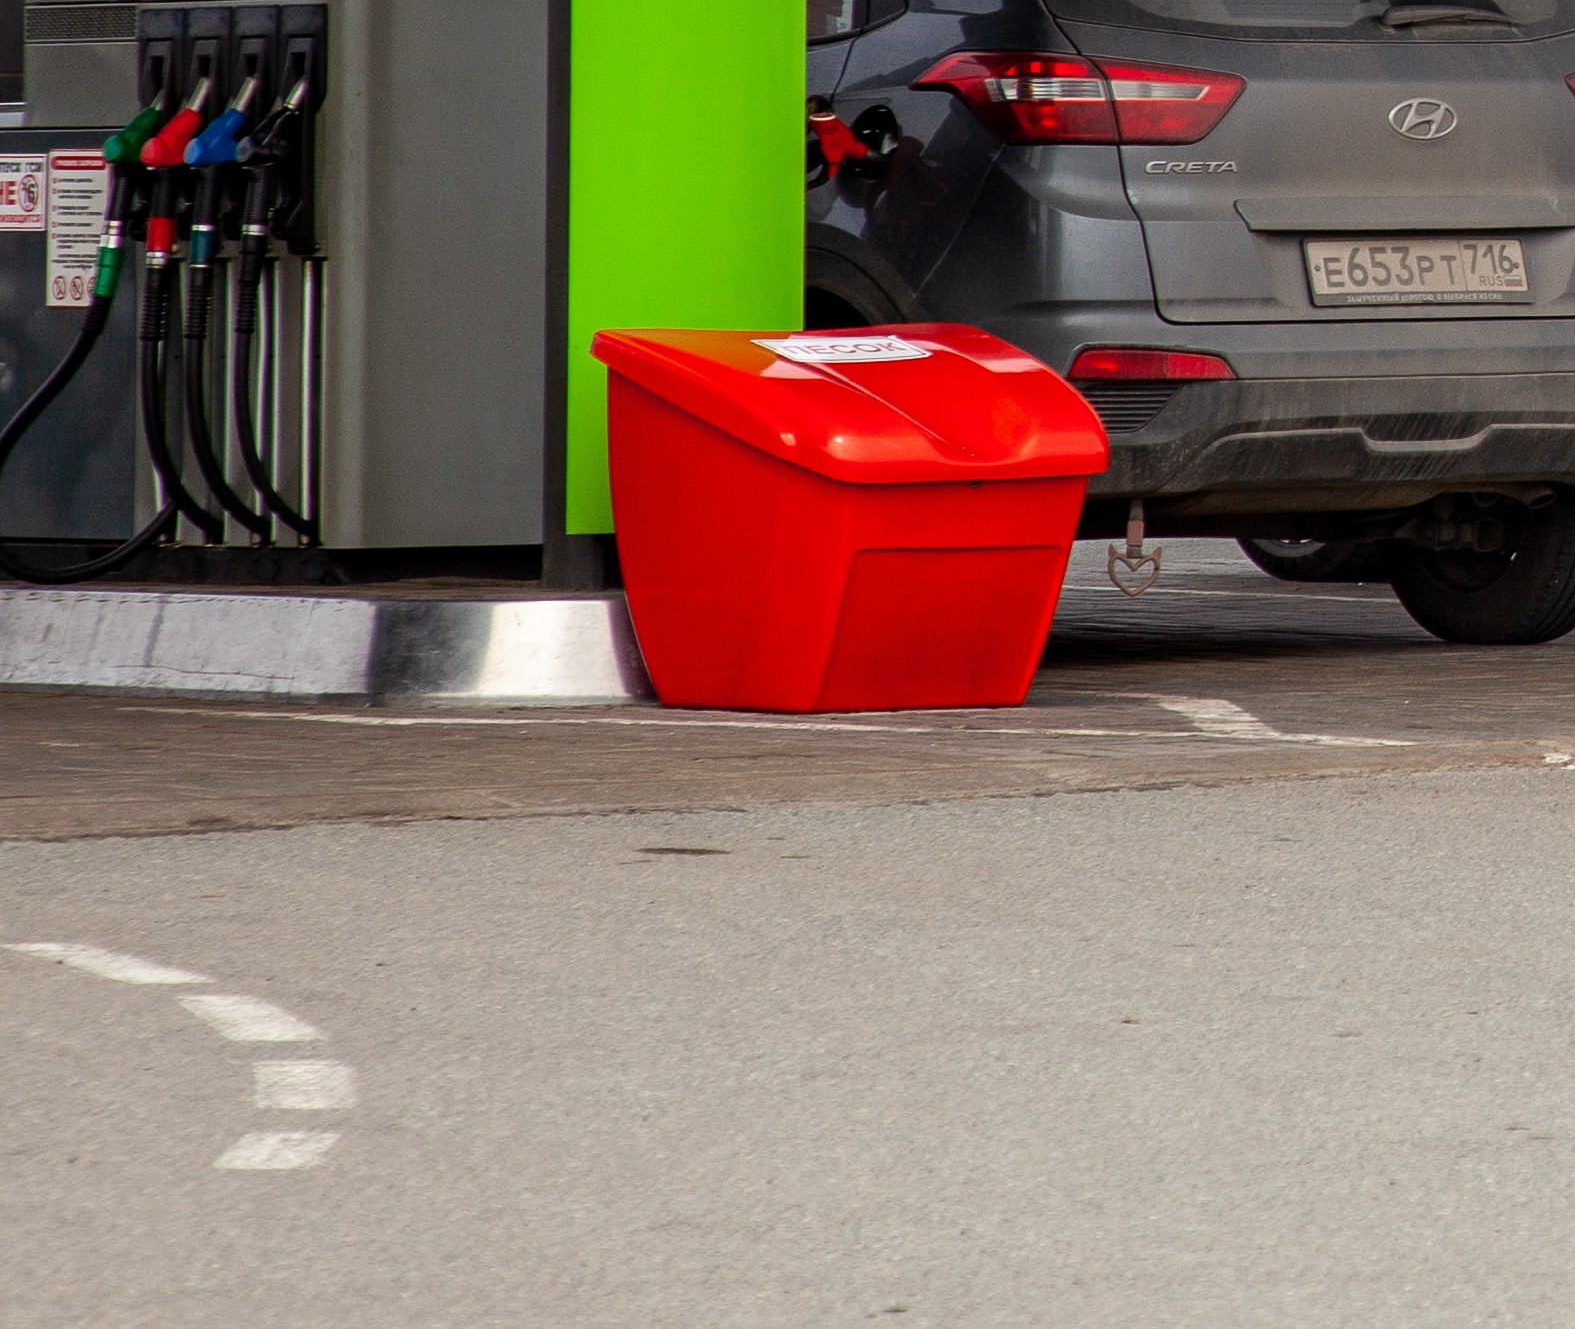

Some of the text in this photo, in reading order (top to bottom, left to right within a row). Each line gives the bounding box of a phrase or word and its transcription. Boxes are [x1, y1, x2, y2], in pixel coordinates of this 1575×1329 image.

[1145, 160, 1238, 174] CRETA
[1322, 244, 1514, 288] Е653РТ 716
[1479, 275, 1504, 287] RUS
[782, 341, 906, 355] ПЕСОК
